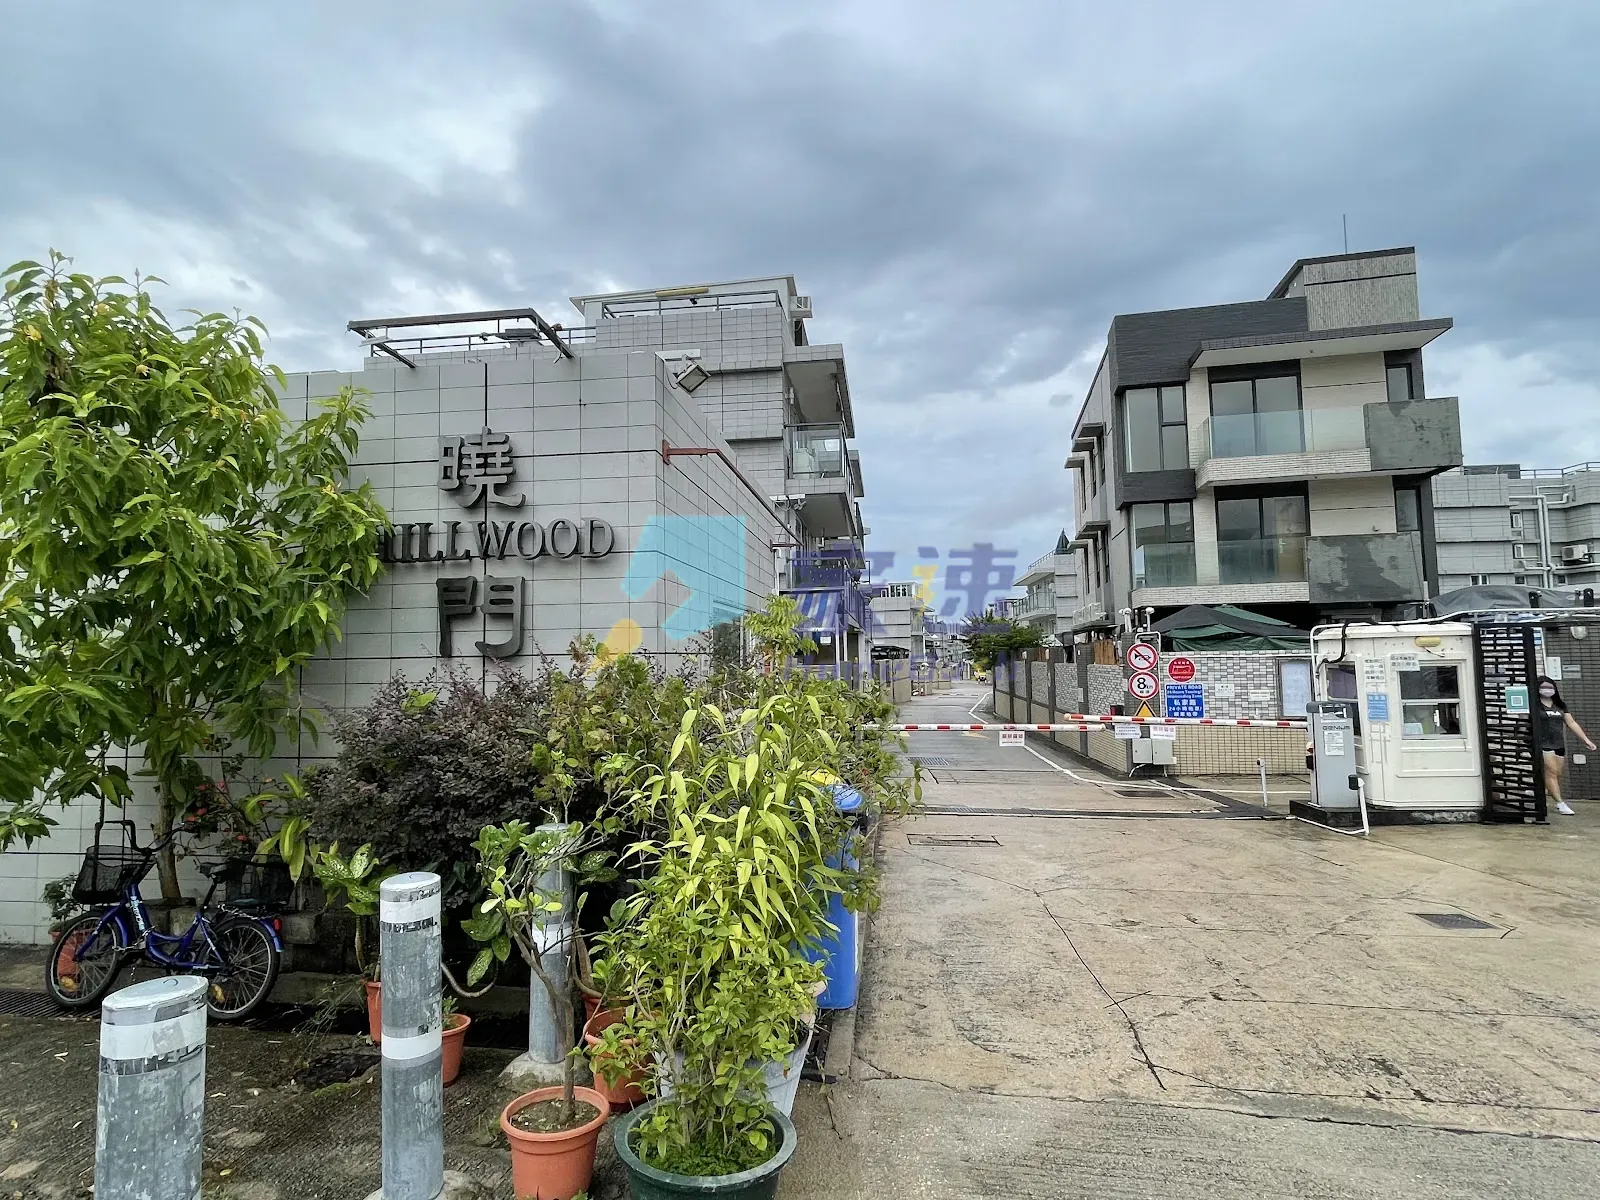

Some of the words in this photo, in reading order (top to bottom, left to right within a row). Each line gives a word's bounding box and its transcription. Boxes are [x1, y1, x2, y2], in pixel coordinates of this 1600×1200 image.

[437, 426, 526, 508] 曉
[436, 575, 526, 658] 門
[1137, 677, 1146, 690] 8
